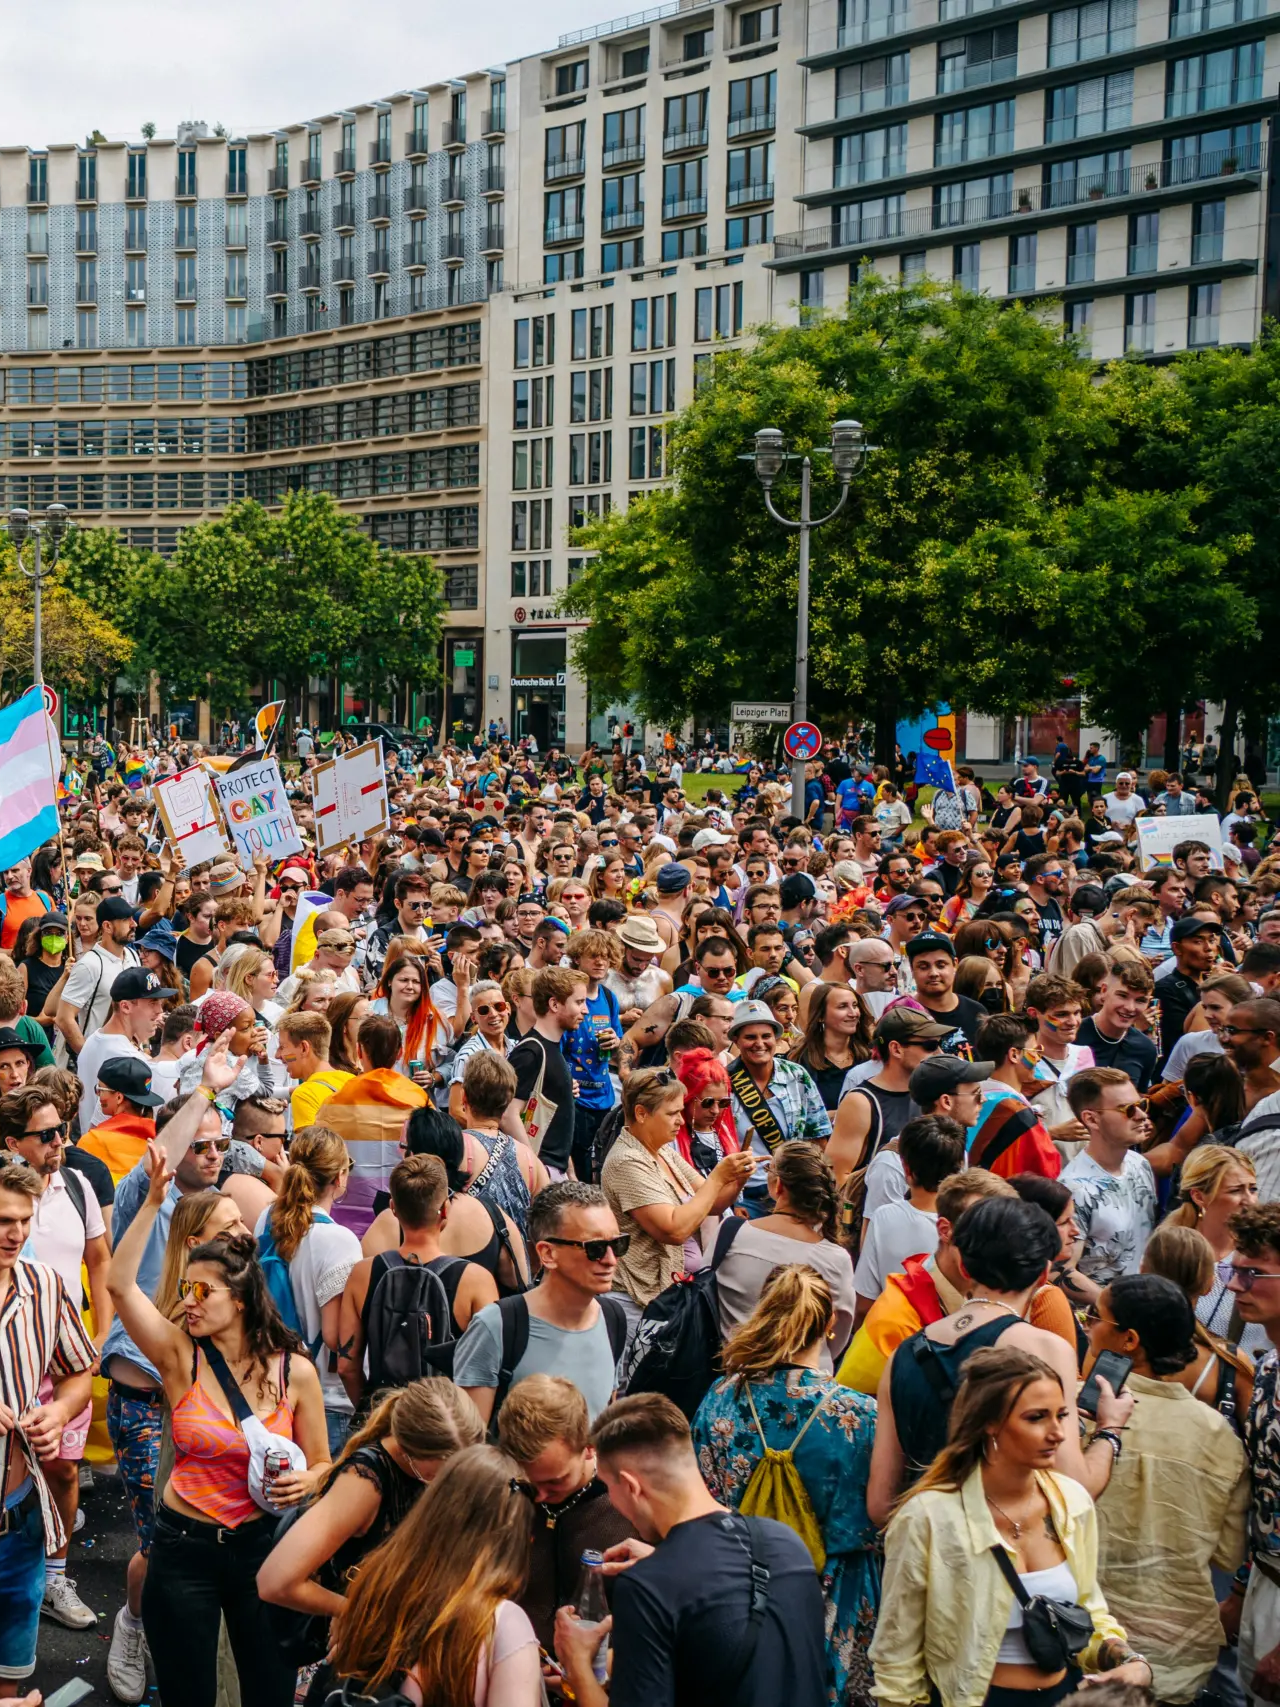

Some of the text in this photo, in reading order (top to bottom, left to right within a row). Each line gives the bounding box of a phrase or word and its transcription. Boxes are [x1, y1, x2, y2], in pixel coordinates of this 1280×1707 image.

[510, 678, 554, 686] Deutsche Bank
[736, 706, 788, 718] Leipziger Platz
[220, 768, 275, 798] PROTECT
[229, 789, 277, 823] GAY
[236, 816, 294, 854] YOUTH
[730, 1069, 784, 1150] MAID OF DI
